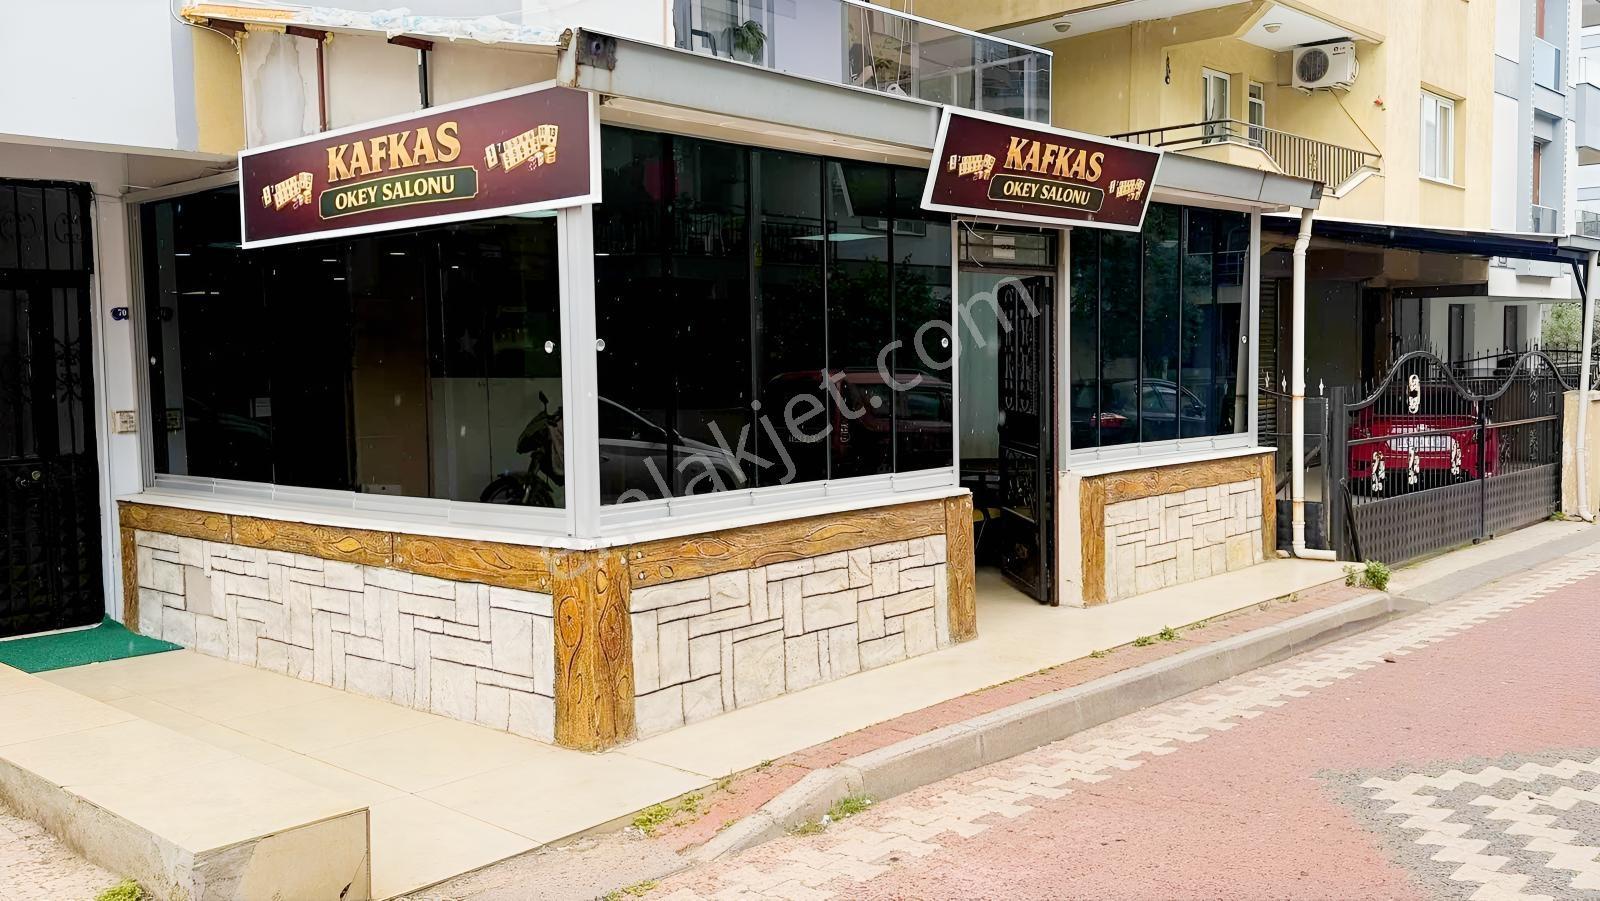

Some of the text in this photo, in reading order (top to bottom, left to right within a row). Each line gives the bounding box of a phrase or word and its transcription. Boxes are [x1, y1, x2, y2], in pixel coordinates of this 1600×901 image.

[326, 121, 461, 183] KAFKAS
[1003, 136, 1105, 182] KAFKAS
[335, 186, 378, 210] OKEY
[382, 174, 455, 201] SALONU
[1003, 180, 1091, 206] OKEY SALONU
